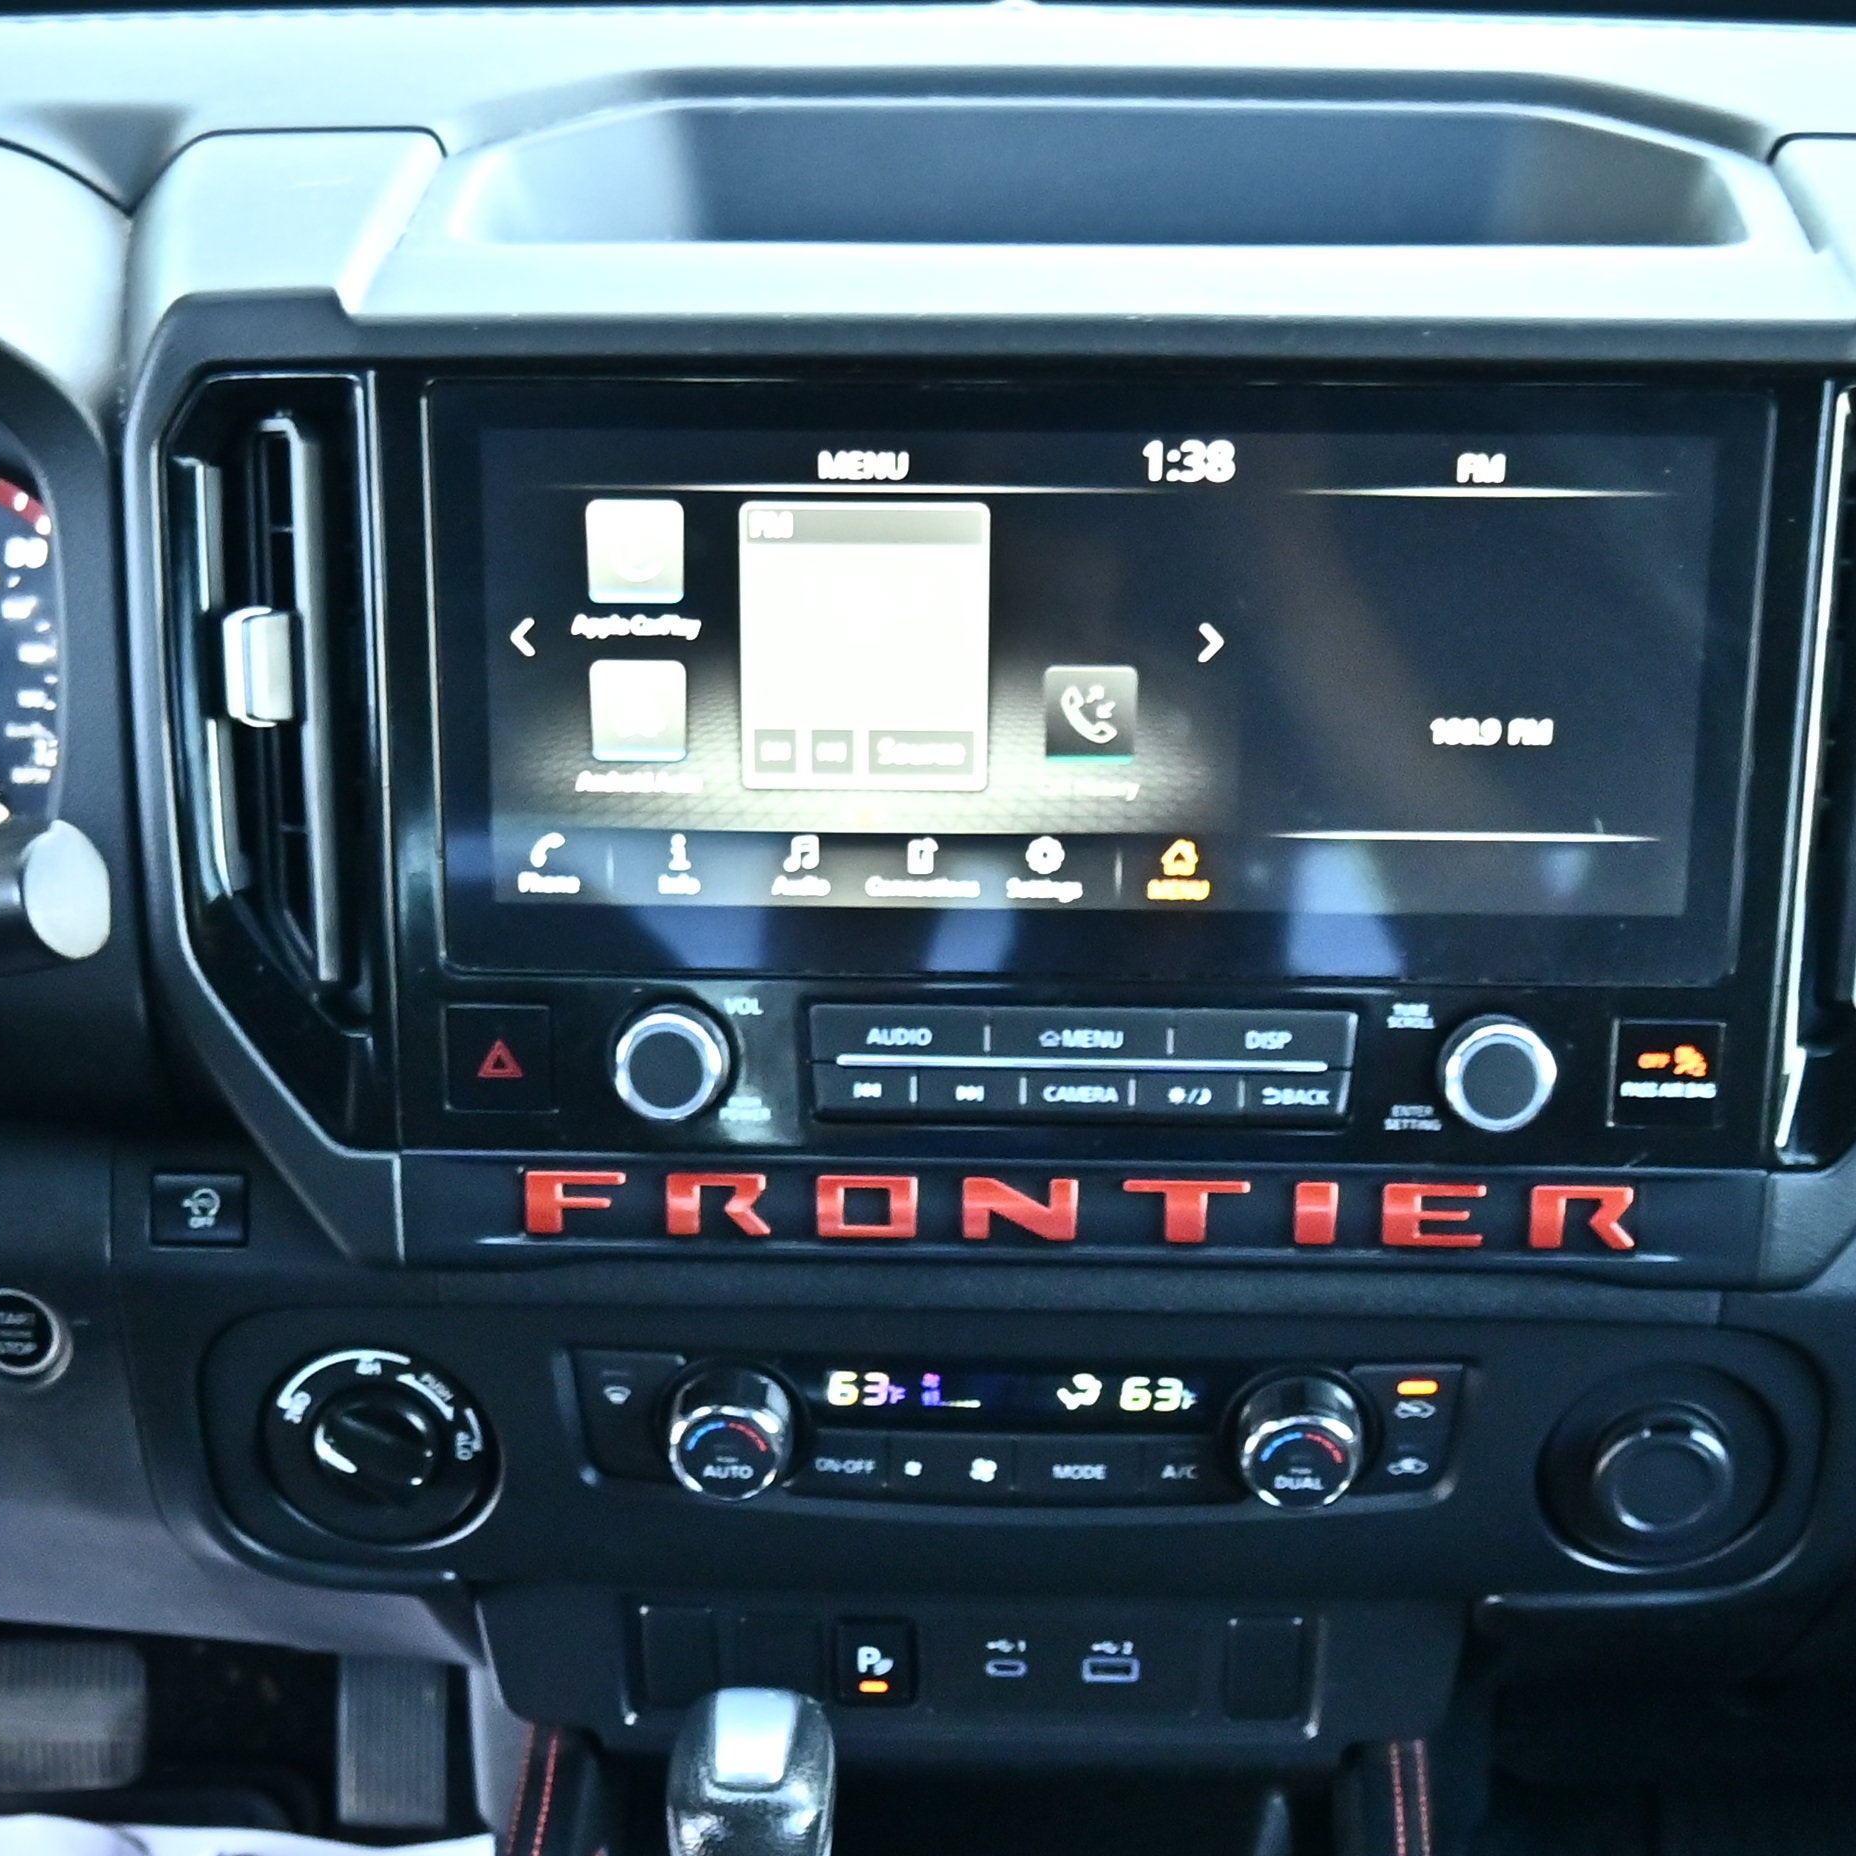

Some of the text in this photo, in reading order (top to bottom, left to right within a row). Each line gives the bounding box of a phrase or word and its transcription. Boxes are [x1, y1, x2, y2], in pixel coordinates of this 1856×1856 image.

[816, 450, 911, 481] MENU
[1143, 439, 1236, 484] 1:38
[1456, 453, 1507, 485] FM
[1147, 878, 1211, 901] MENU
[723, 997, 764, 1016] VOL
[865, 1026, 934, 1048] AUDIO
[1063, 1027, 1124, 1050] MENU
[1244, 1029, 1293, 1050] DISP
[1043, 1084, 1119, 1105] CAMERA
[1283, 1086, 1331, 1106] BACK
[524, 1169, 1636, 1250] FRONTIER
[702, 1464, 755, 1480] AUTO
[1052, 1463, 1107, 1480] MODE
[1160, 1463, 1199, 1480] A/C
[1273, 1475, 1325, 1491] DUAL
